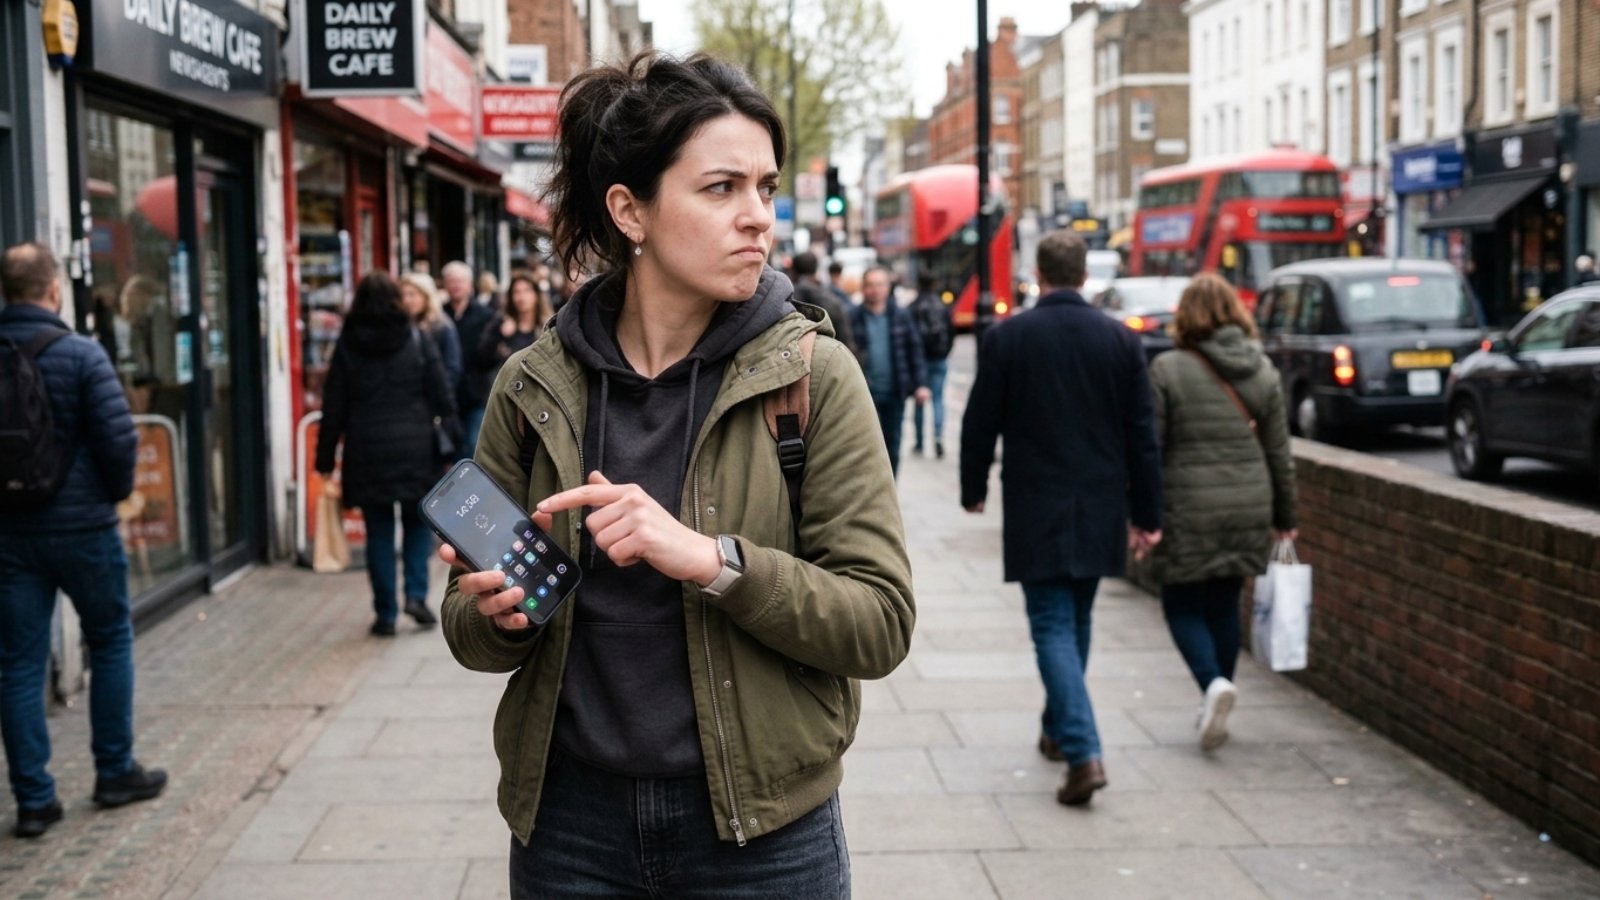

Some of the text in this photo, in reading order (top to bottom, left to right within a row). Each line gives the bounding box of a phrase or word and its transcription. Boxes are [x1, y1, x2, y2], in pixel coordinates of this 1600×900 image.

[325, 2, 396, 24] DAILY
[180, 0, 226, 58] BREW
[226, 22, 263, 75] CAFE
[325, 27, 397, 50] BREW
[328, 53, 394, 76] CAFE
